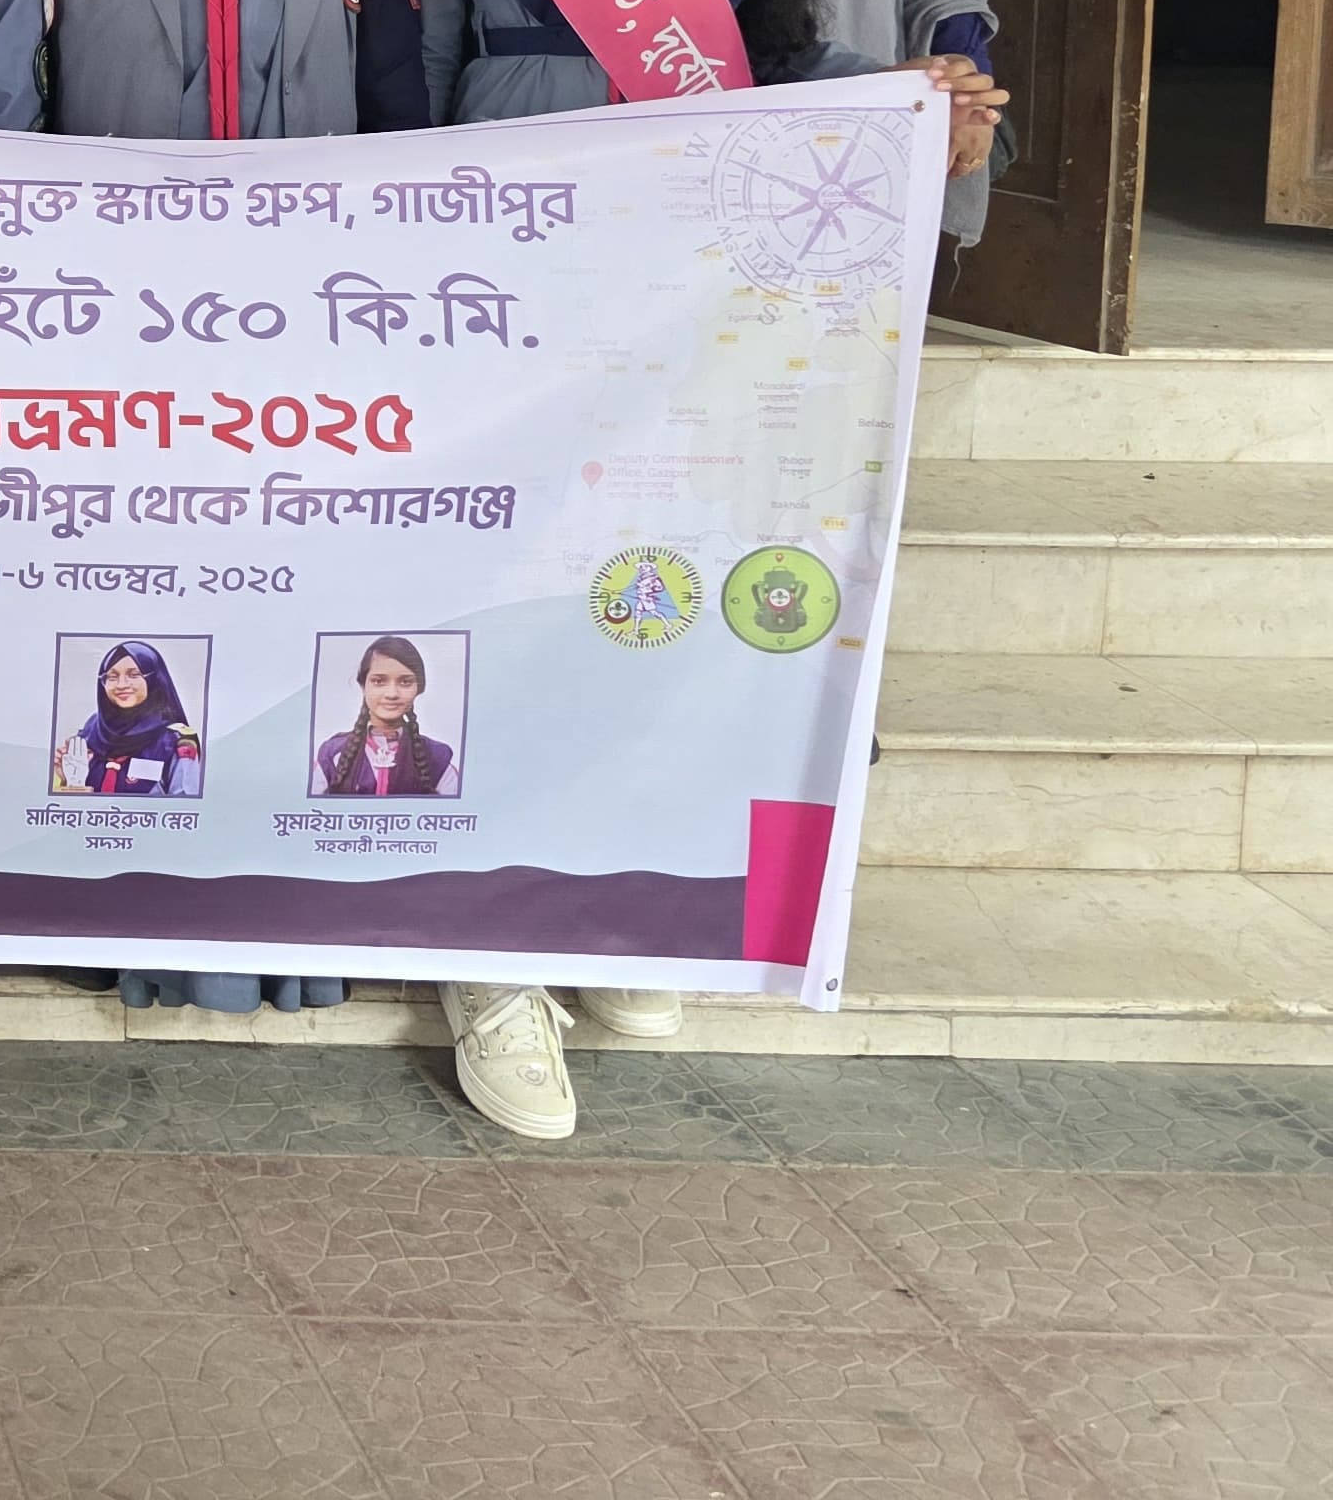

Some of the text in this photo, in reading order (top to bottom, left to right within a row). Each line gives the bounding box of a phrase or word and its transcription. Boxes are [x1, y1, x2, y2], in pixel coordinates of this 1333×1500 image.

[92, 176, 233, 227] স্কাউট
[245, 180, 356, 231] গ্রুপ,
[372, 166, 577, 242] গাজীপুর
[136, 290, 287, 344] ১৫০
[313, 271, 540, 349] কি.মি.
[607, 453, 745, 467] Deputy Commissioner's
[125, 483, 249, 527] থেকে
[261, 471, 517, 531] কিশোরগঞ্জ
[54, 561, 186, 597] নভেম্বর,
[198, 564, 295, 595] ২০২৫
[25, 804, 200, 830] মালিহা ফাইরুজ স্নেহা
[272, 808, 478, 837] সুমাইয়া জান্নাত মেঘলা
[84, 832, 133, 853] সদস্য
[313, 835, 438, 856] সহকারী দলনেতা
